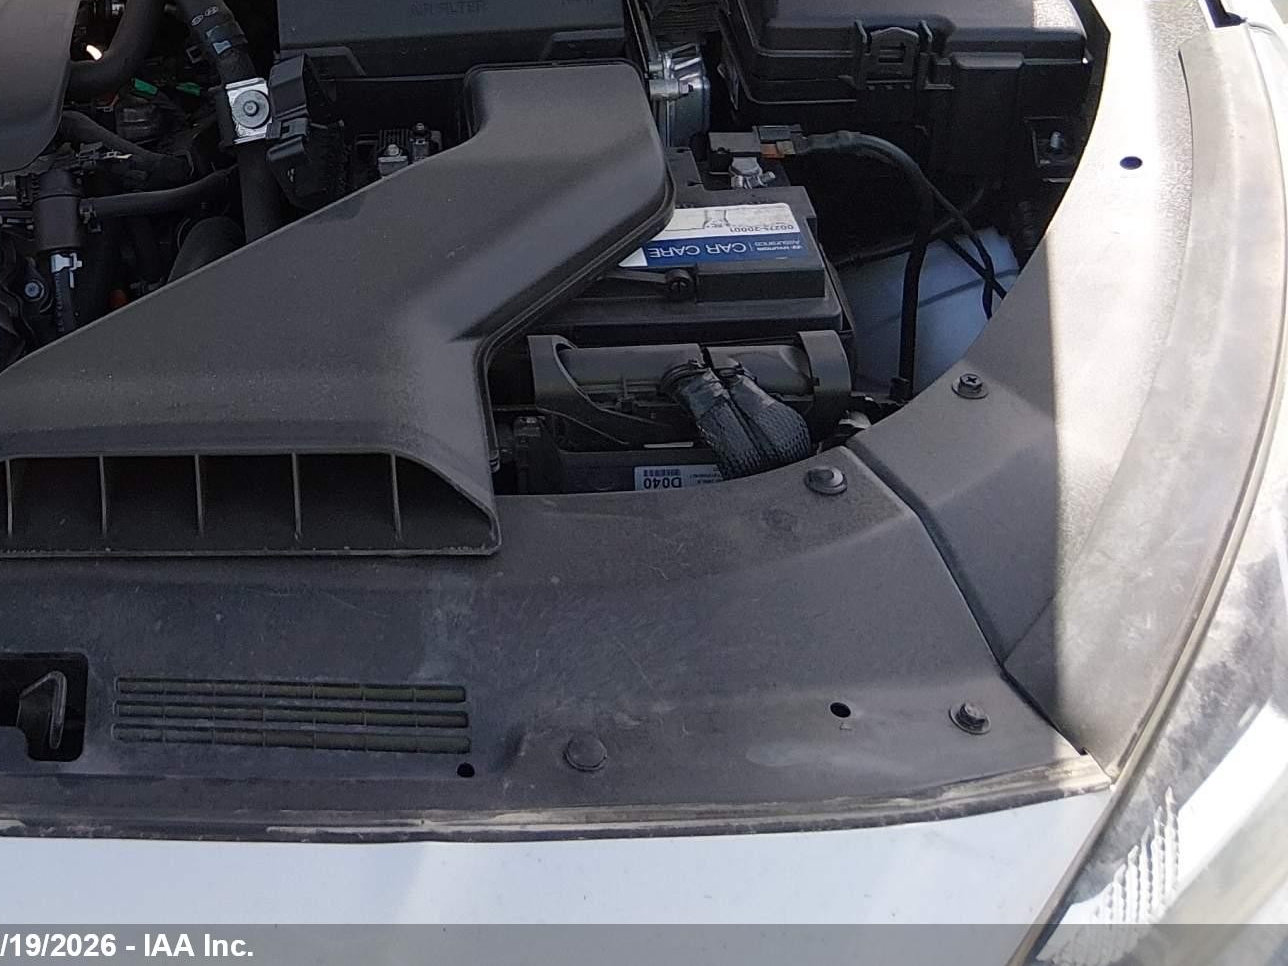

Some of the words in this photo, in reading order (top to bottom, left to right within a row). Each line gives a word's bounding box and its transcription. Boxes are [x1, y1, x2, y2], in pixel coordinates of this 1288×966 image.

[438, 0, 488, 15] FILTER
[648, 245, 700, 258] CARE
[707, 242, 746, 254] CAR
